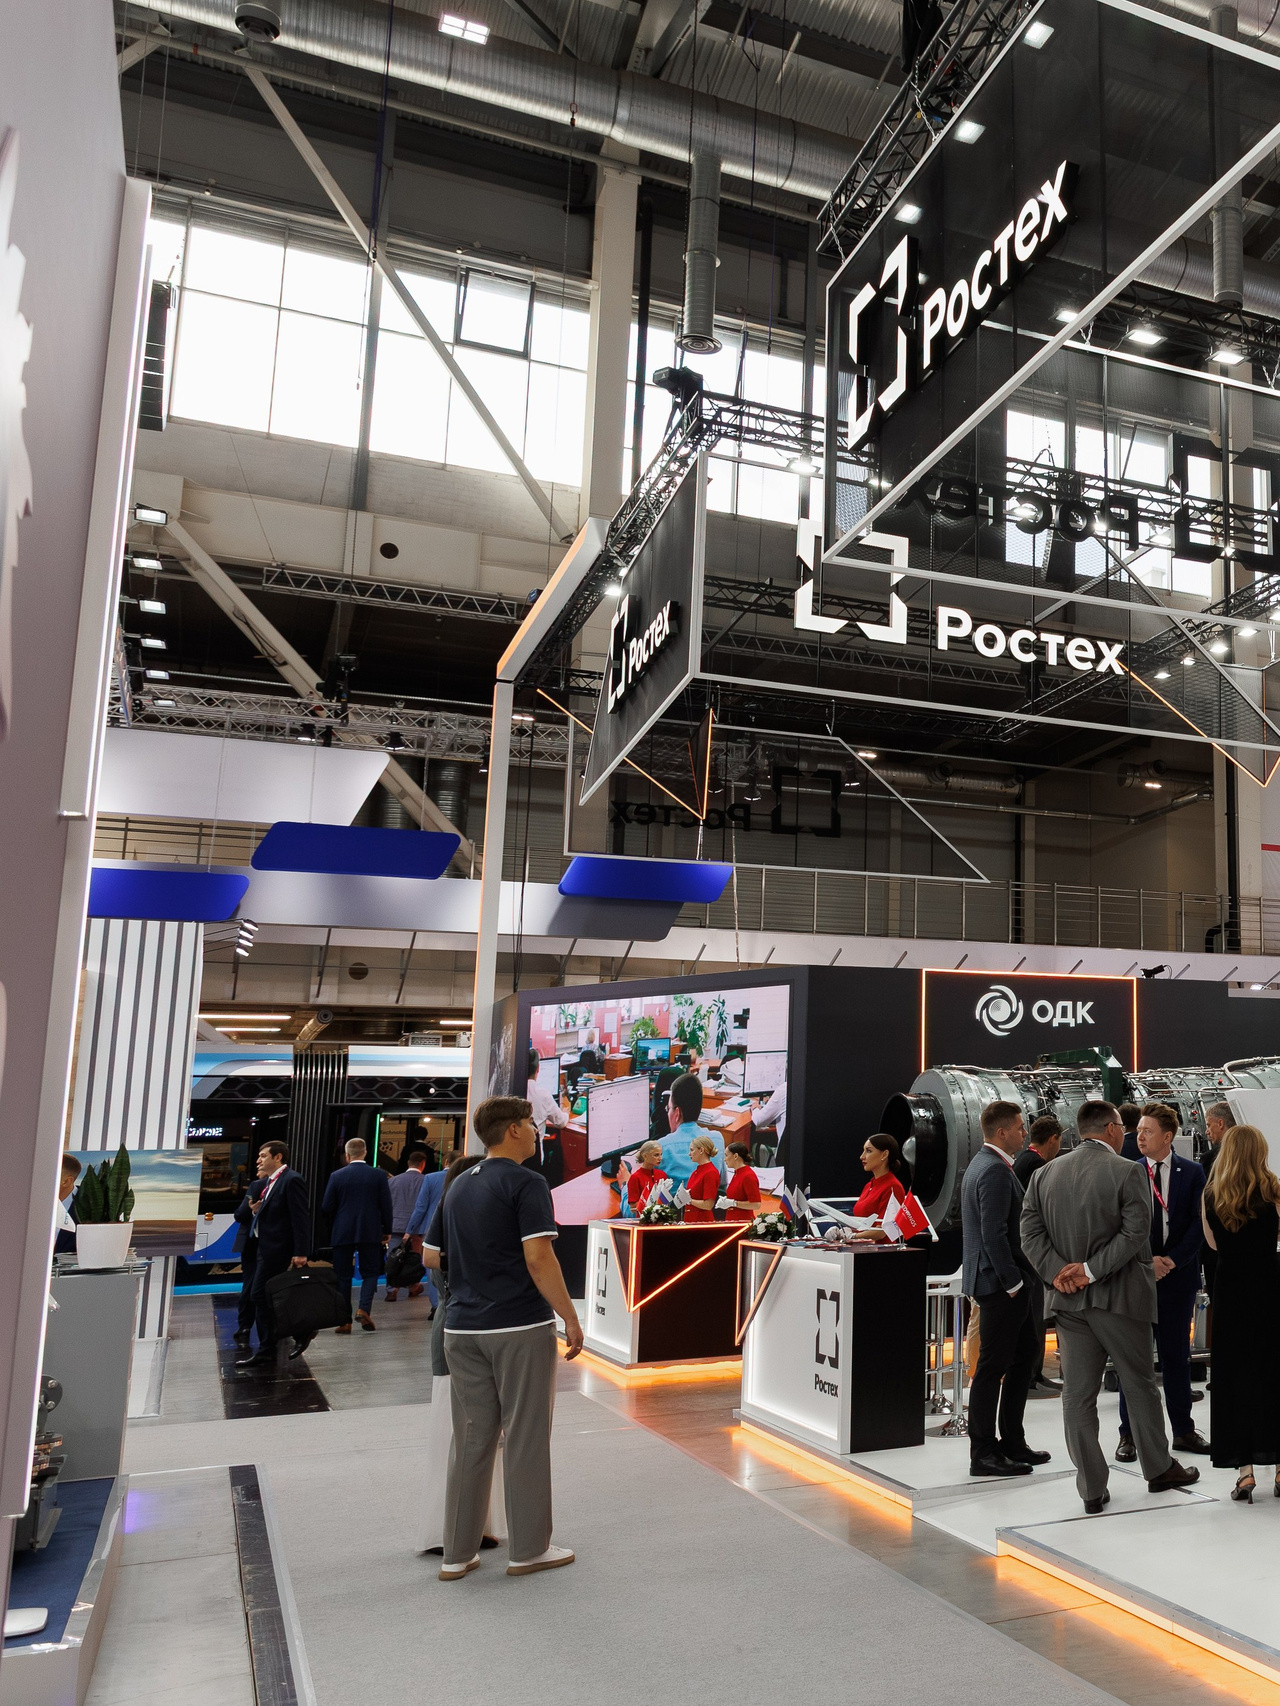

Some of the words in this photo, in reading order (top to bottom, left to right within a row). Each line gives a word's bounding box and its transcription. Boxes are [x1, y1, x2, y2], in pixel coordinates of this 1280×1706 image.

[922, 160, 1069, 369] Ростех
[628, 600, 671, 684] Ростех
[936, 605, 1126, 676] Ростех
[1032, 999, 1096, 1027] ОДК
[814, 1373, 839, 1398] Ростех
